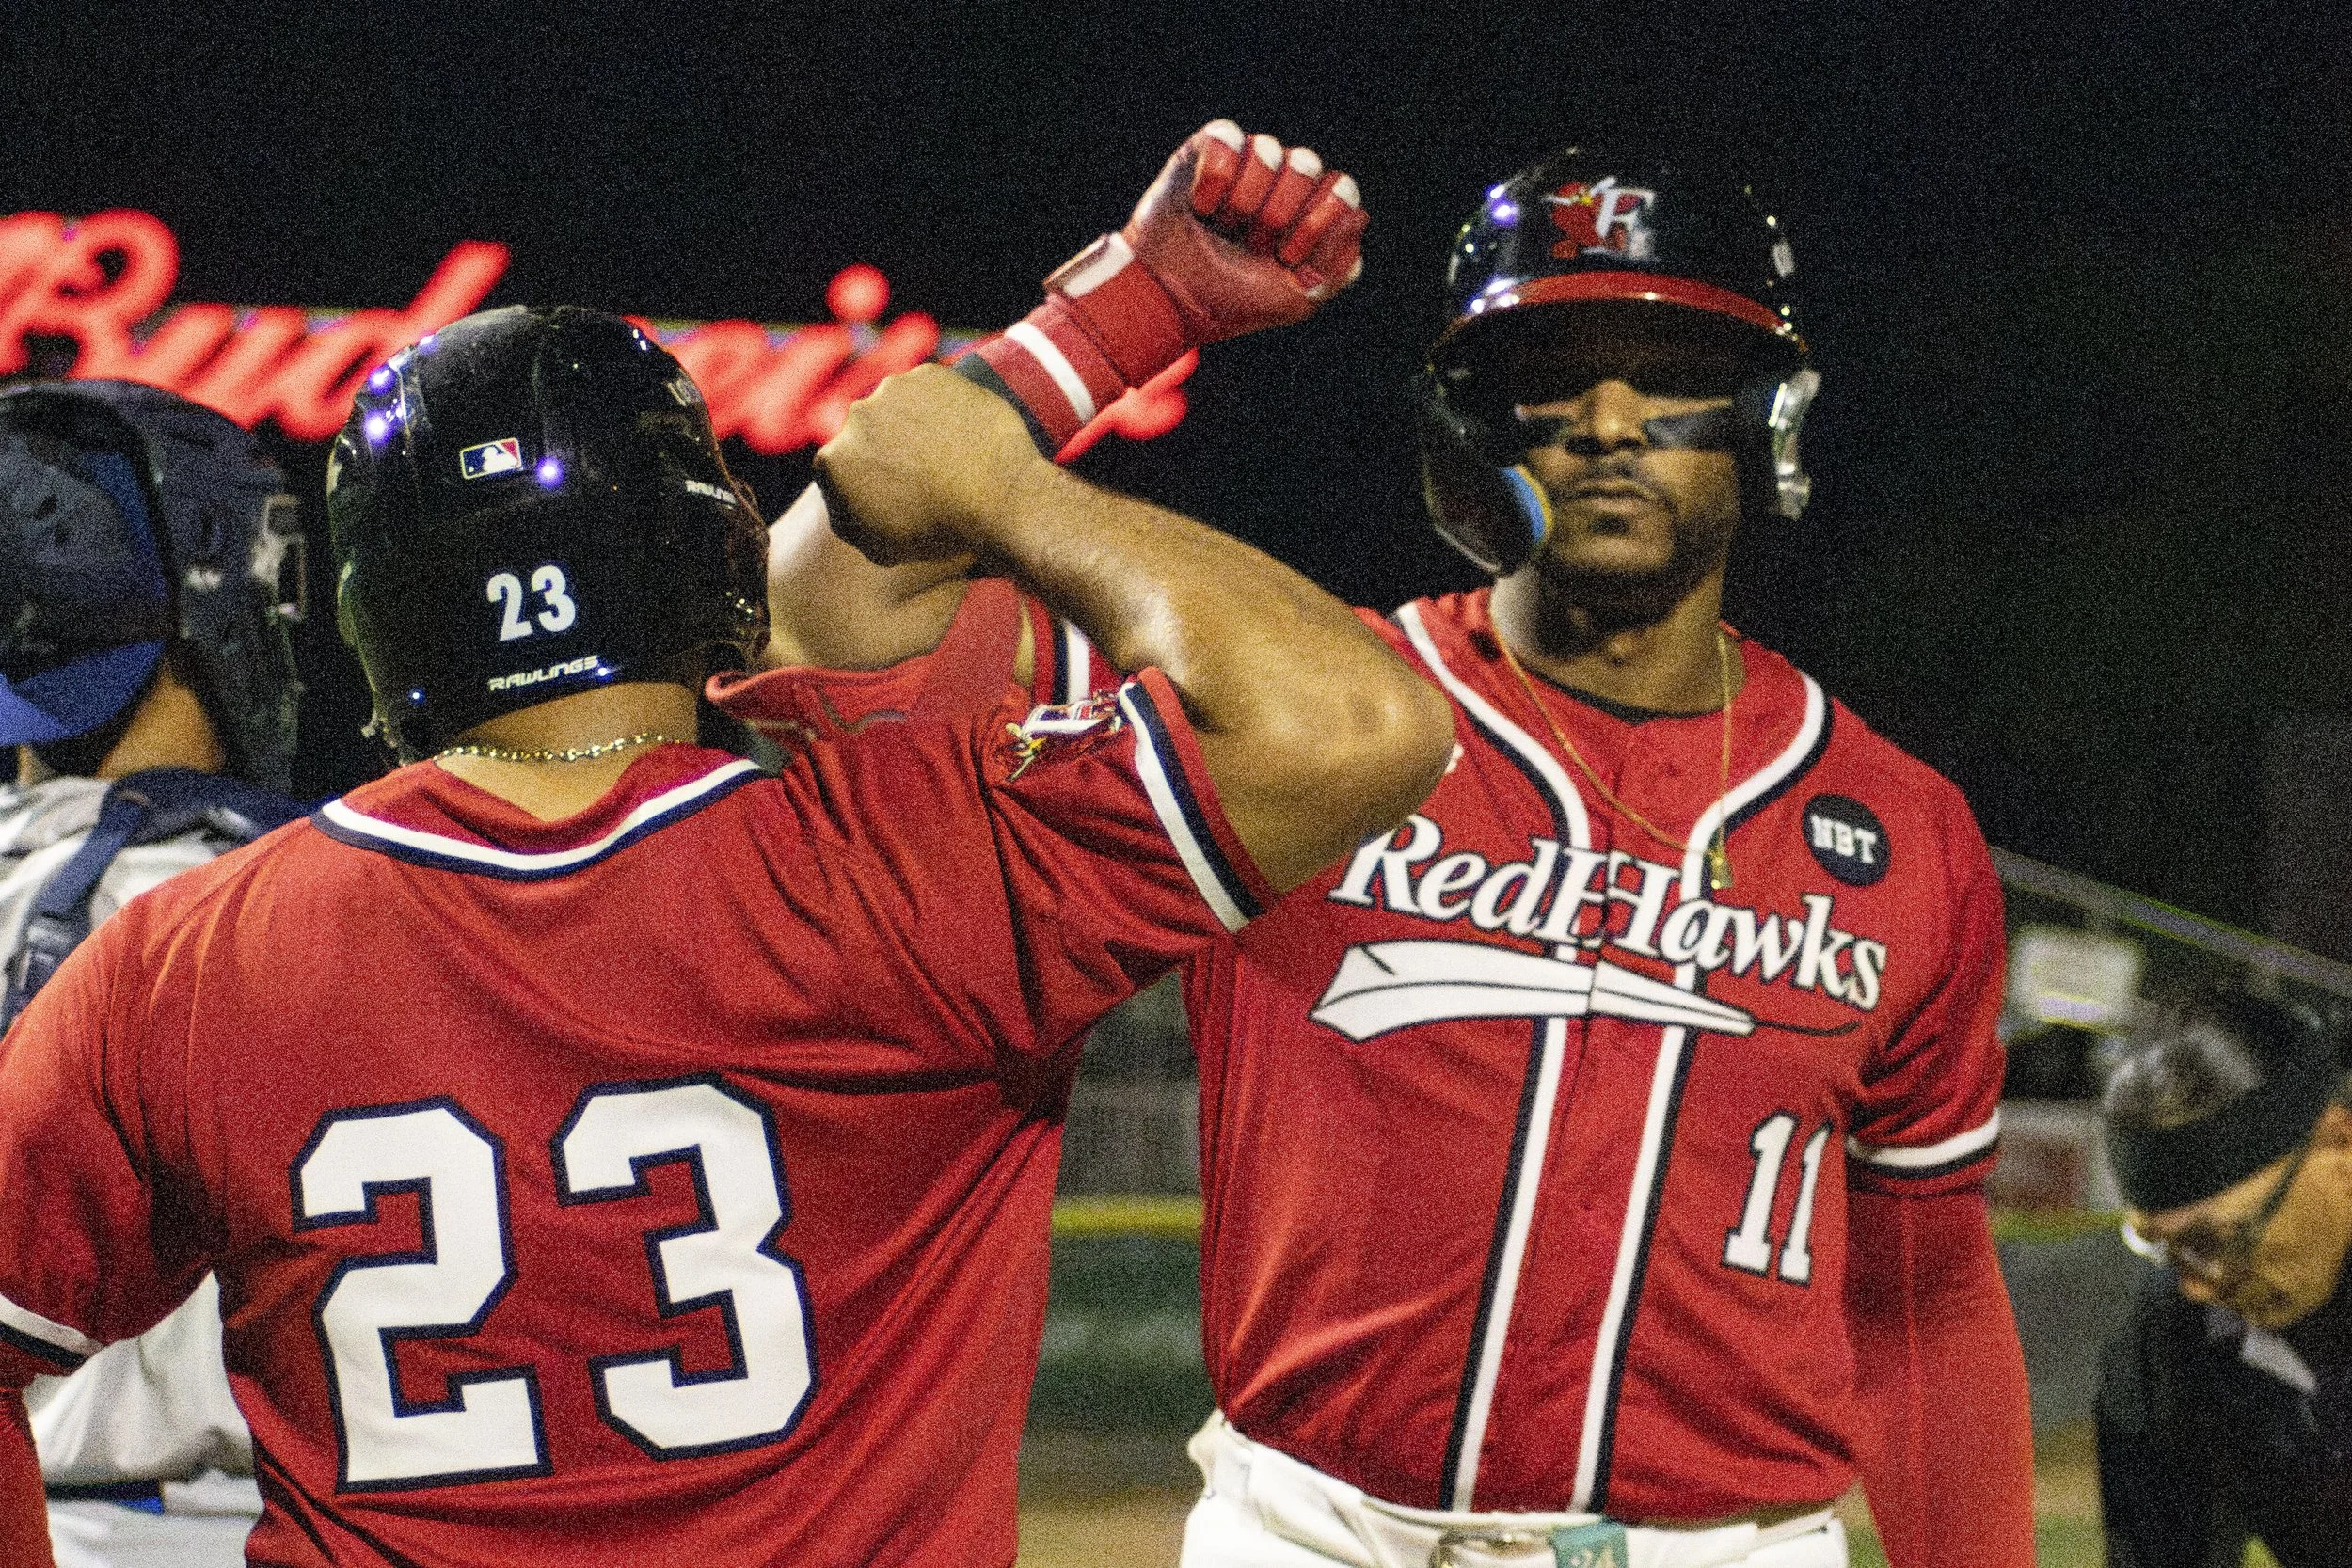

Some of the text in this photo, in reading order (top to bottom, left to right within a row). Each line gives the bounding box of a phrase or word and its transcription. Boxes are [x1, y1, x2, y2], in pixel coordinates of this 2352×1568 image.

[487, 565, 576, 641] 23
[487, 655, 599, 692] RAWLINGS
[1327, 813, 1886, 1011] RedHawks
[289, 1072, 819, 1494] 23
[1723, 1109, 1834, 1286] 11
